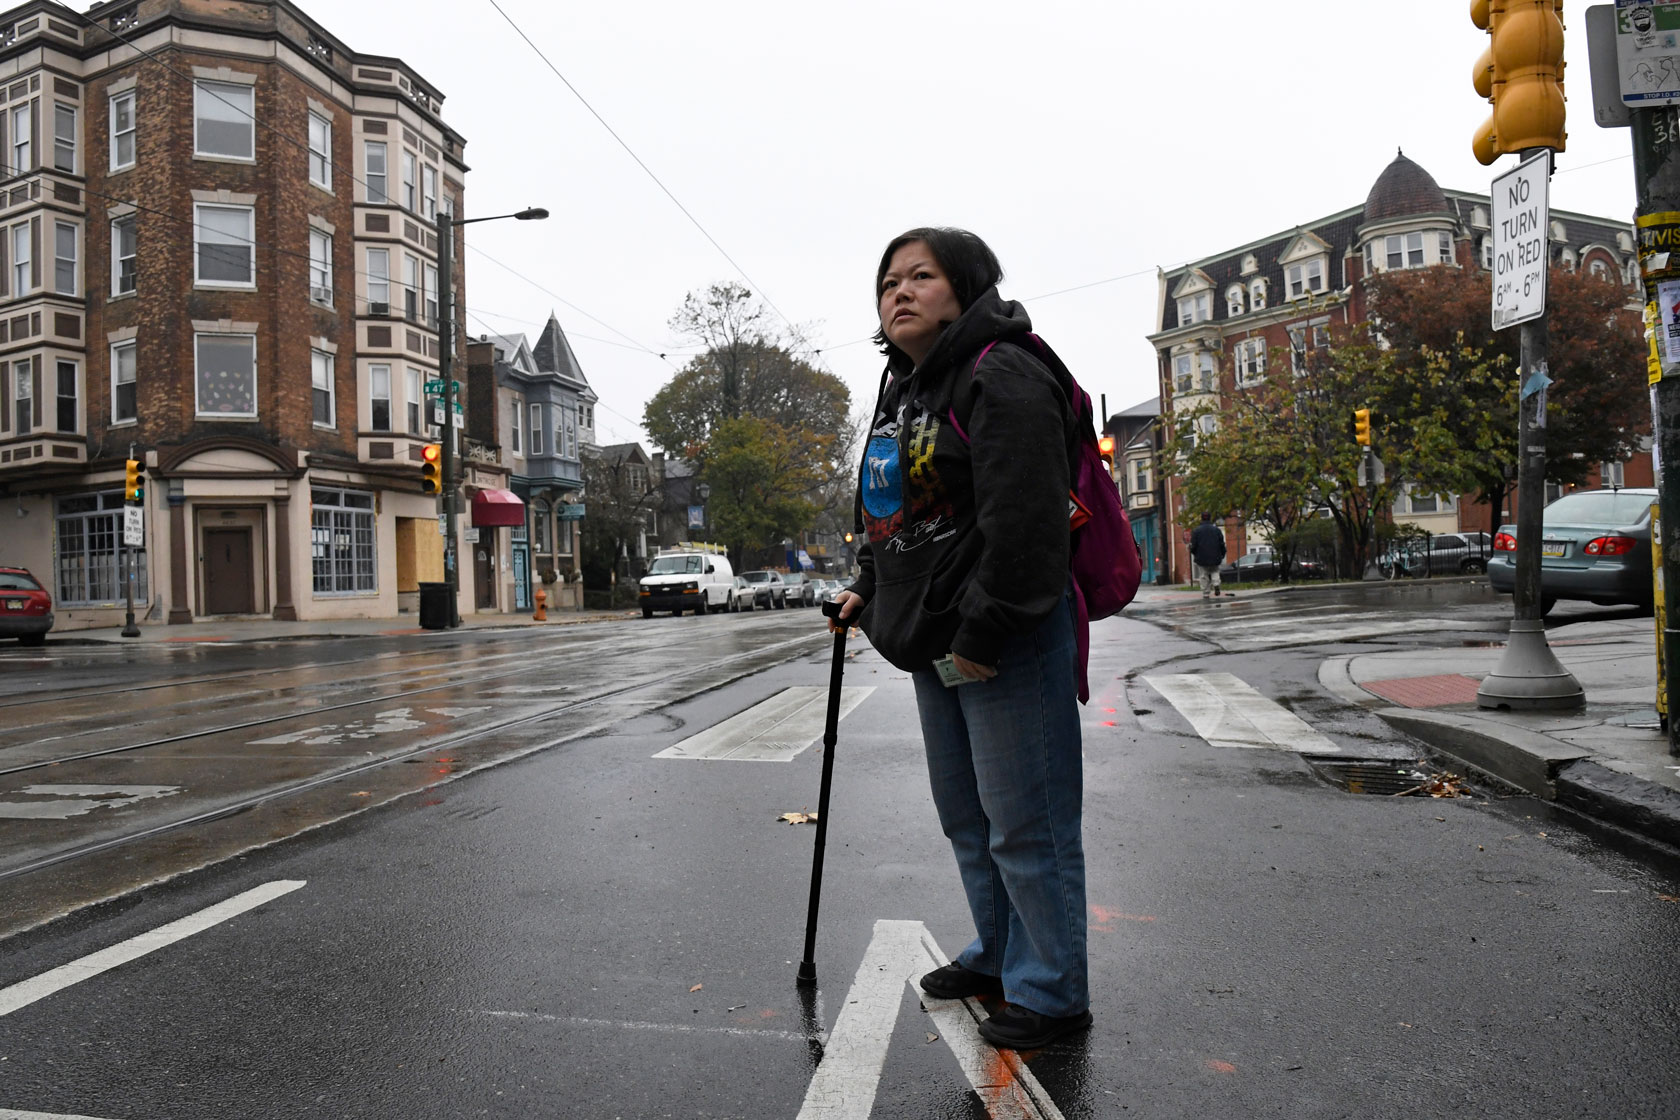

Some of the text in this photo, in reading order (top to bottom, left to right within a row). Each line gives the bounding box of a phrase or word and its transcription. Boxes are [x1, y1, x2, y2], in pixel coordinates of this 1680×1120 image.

[1509, 179, 1530, 209] NO
[1502, 206, 1538, 243] TURN
[1497, 238, 1541, 275] ON RED
[130, 510, 138, 518] NO
